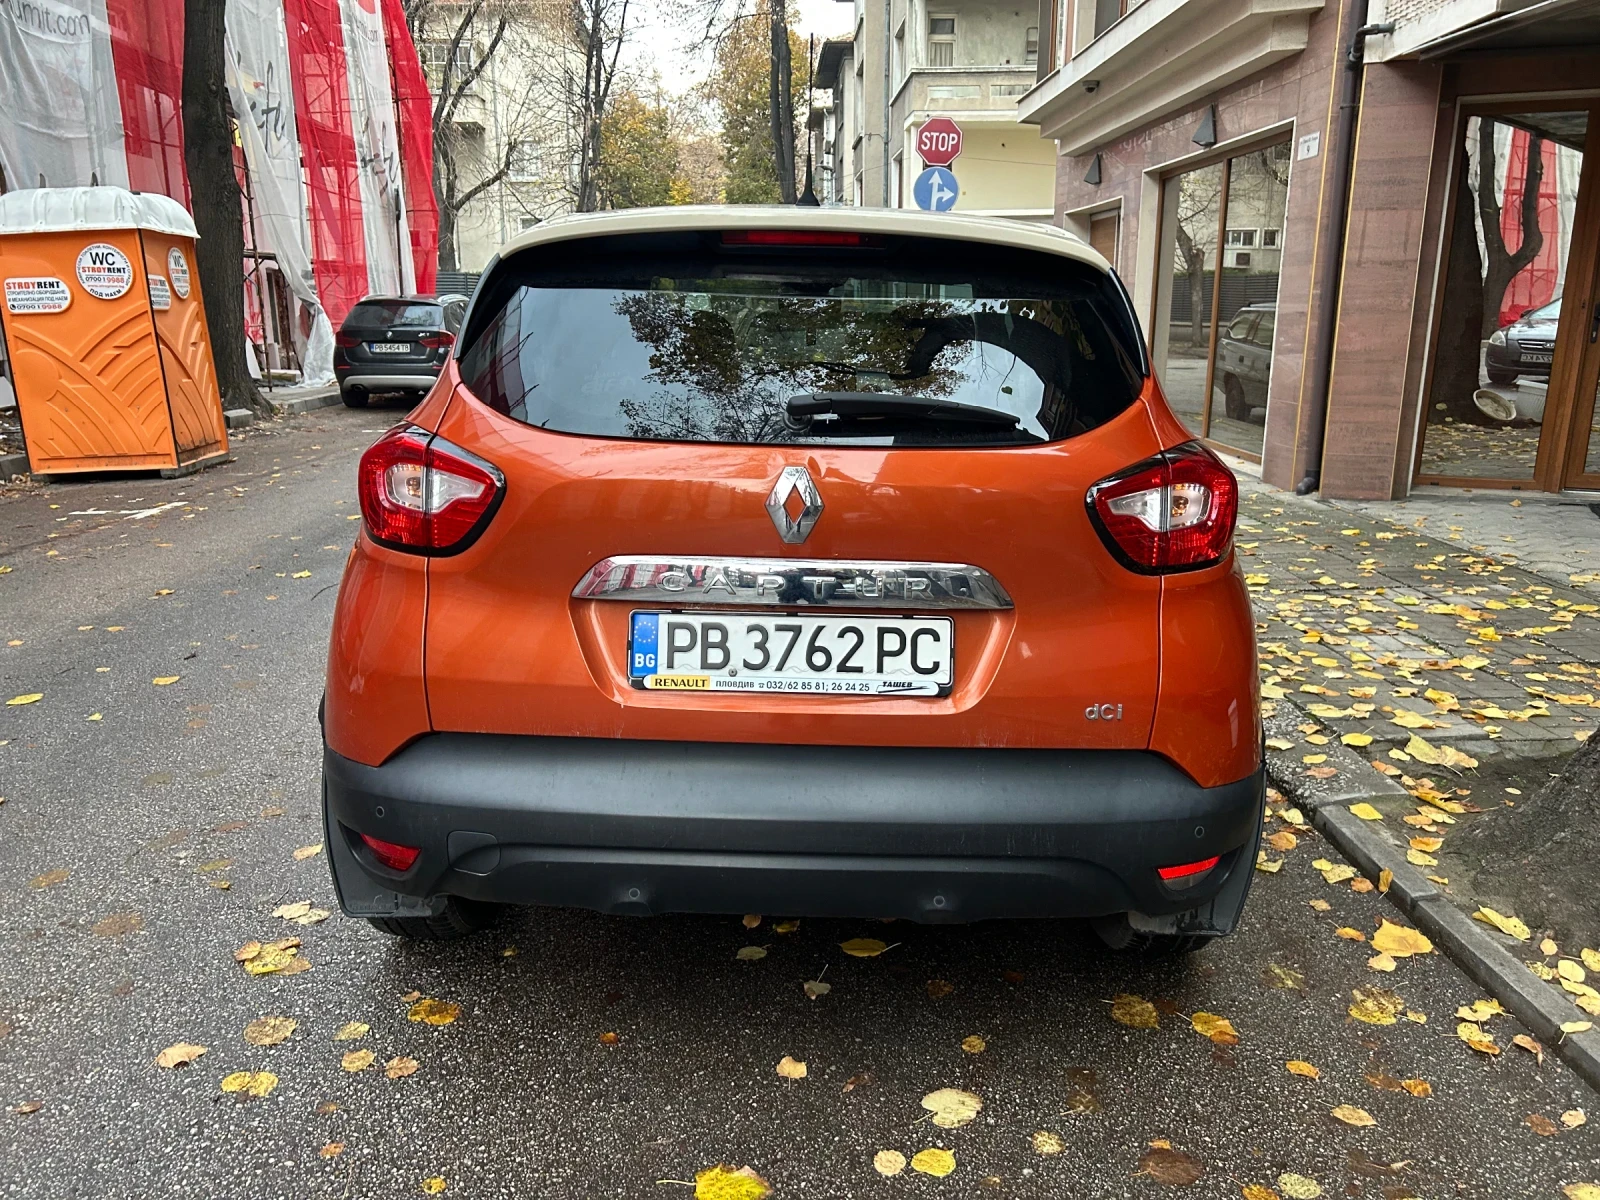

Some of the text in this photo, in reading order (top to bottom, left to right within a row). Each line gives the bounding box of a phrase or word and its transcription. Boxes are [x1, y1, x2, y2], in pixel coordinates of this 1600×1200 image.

[9, 0, 91, 36] umit.com
[921, 131, 958, 152] STOP
[90, 252, 116, 266] WC
[81, 266, 126, 274] STROYRENT
[5, 281, 60, 290] STROYRENT
[90, 288, 122, 298] ПОД НАЕМ
[656, 571, 934, 599] CAPTUR
[666, 621, 941, 675] PB 3762 PC
[634, 653, 656, 668] BG
[654, 678, 707, 688] RENAULT
[766, 681, 799, 690] 032/62
[801, 682, 812, 690] 85
[814, 682, 828, 692] 81;
[831, 682, 842, 691] 26
[845, 682, 856, 691] 24
[858, 683, 870, 691] 25
[1085, 703, 1123, 720] dCi
